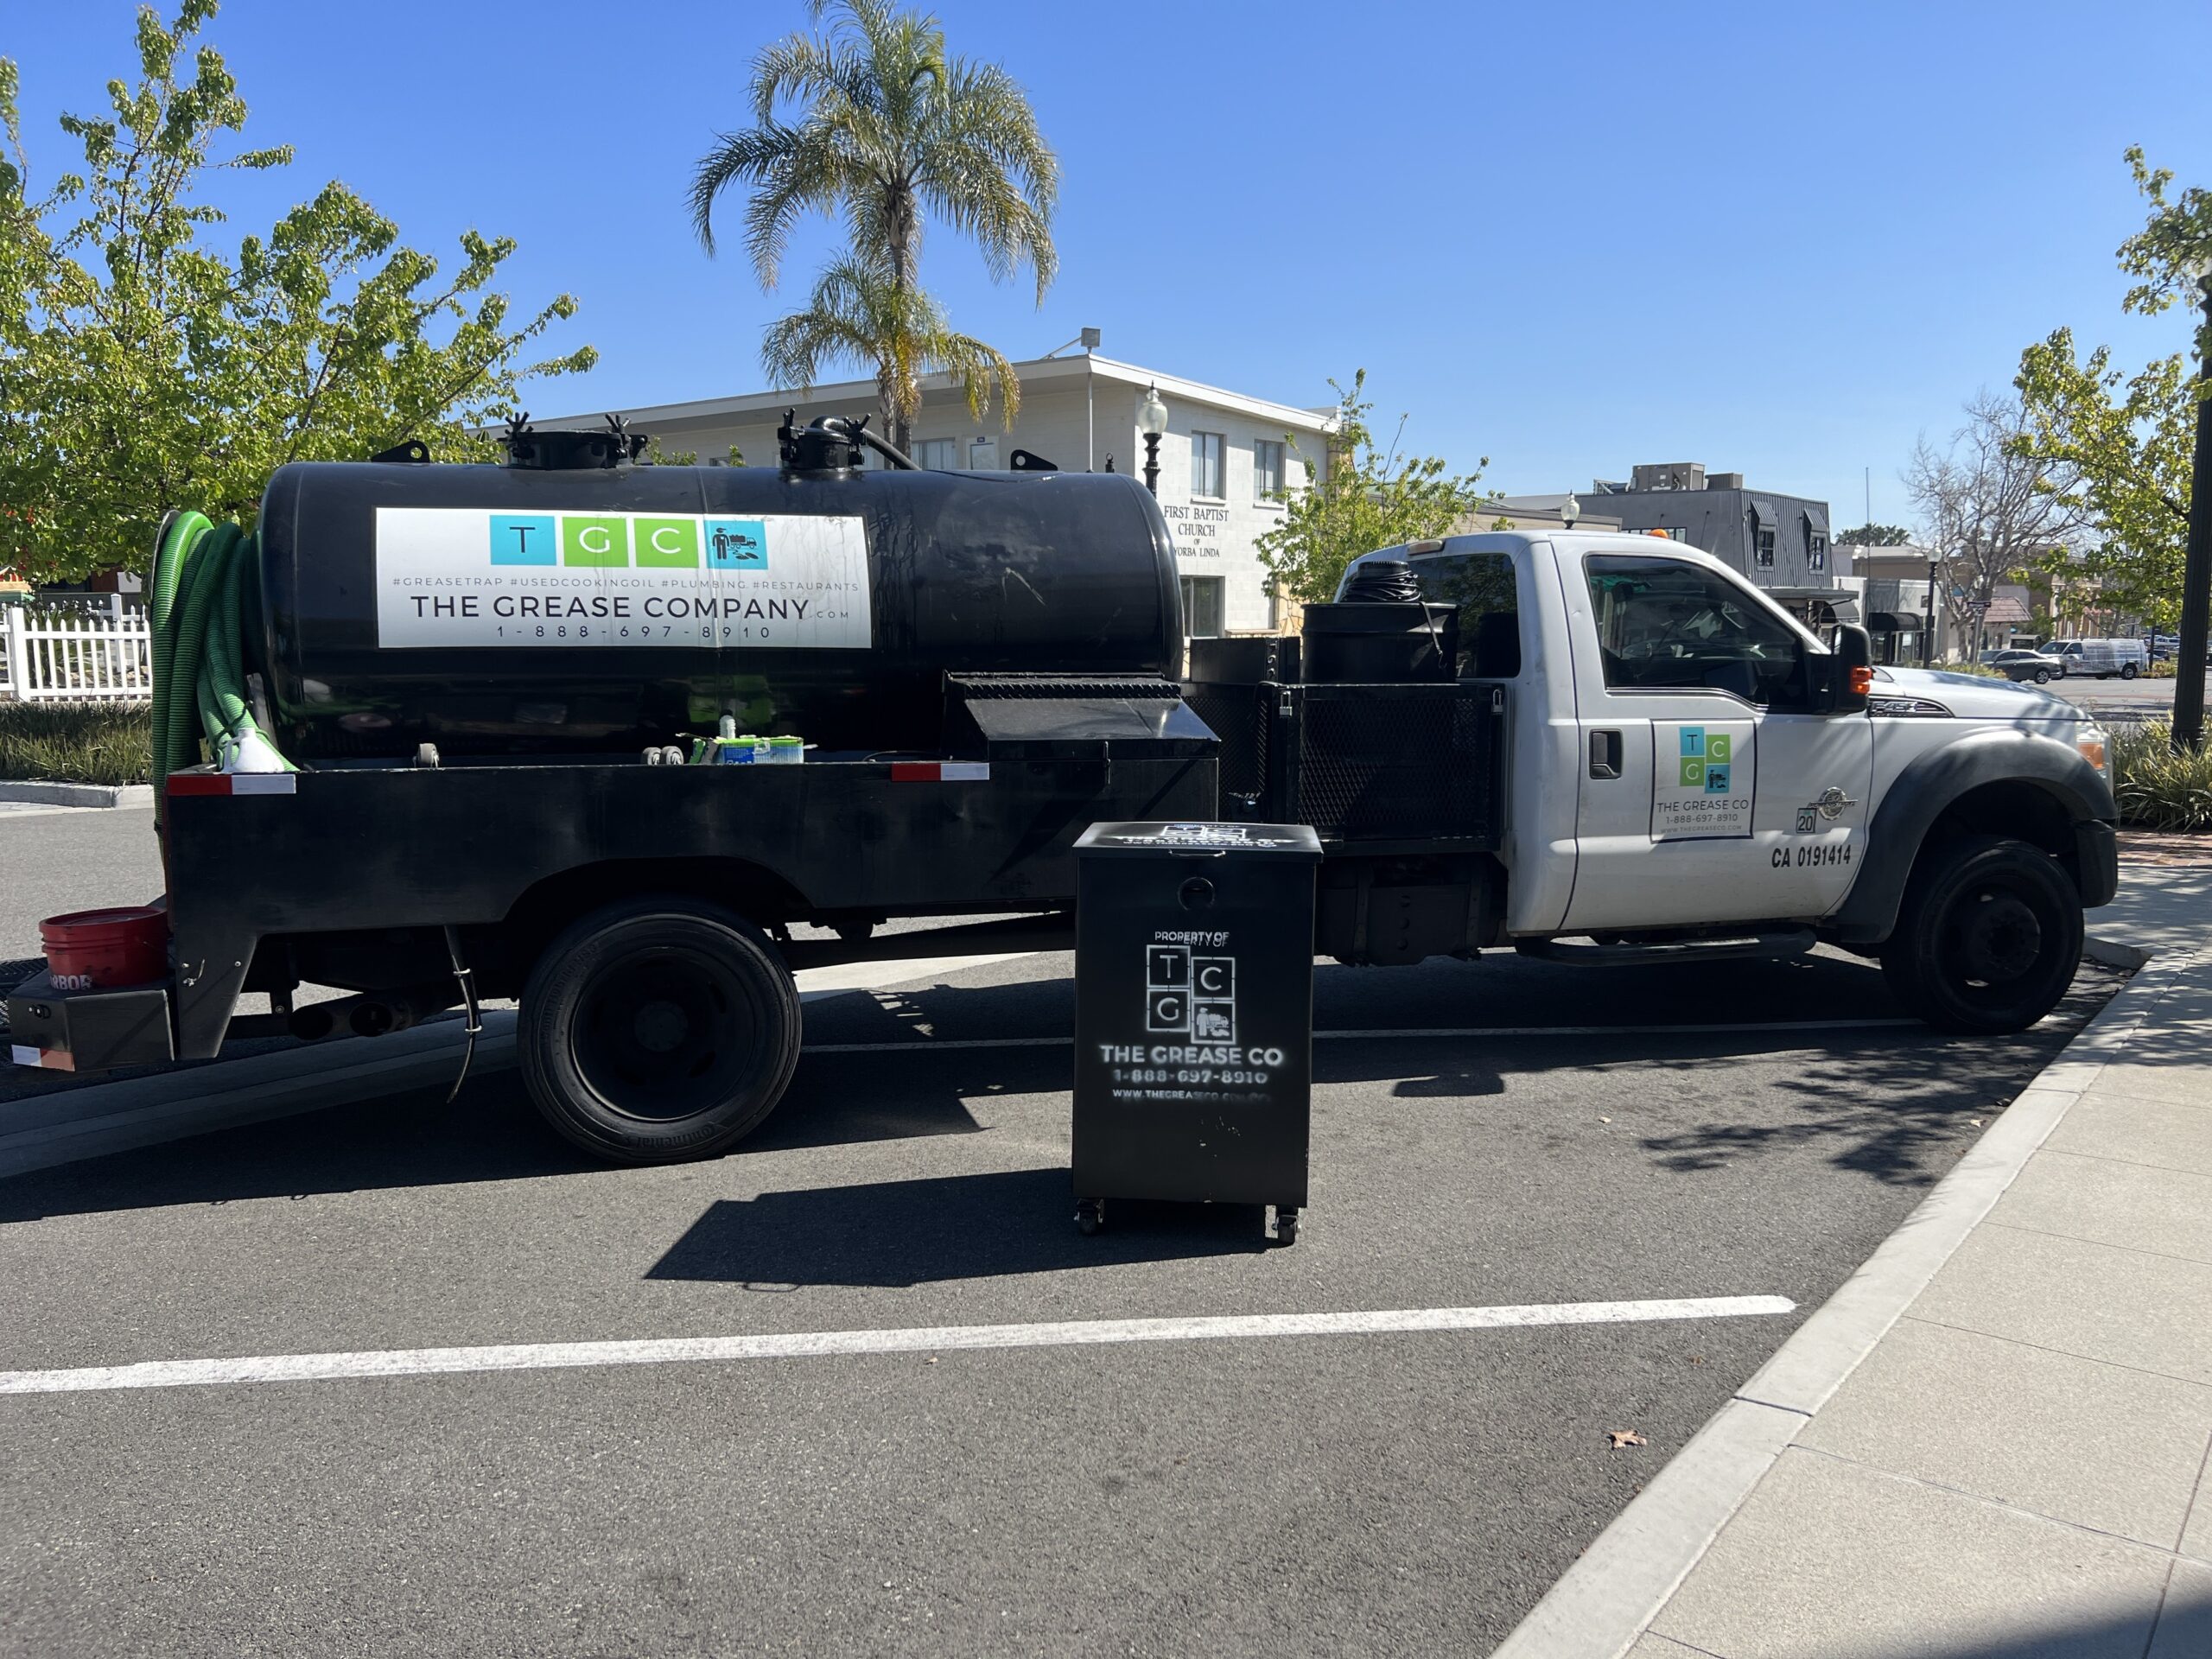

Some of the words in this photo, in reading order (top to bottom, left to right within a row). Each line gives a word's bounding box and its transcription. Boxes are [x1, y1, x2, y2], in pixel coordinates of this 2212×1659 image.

[1164, 505, 1189, 519] FIRST
[1194, 508, 1229, 521] BAPTIST
[1178, 523, 1215, 537] CHURCH
[509, 526, 536, 553] T
[579, 526, 610, 553] G
[651, 528, 682, 554] C
[1200, 548, 1219, 557] LINDA
[393, 577, 503, 587] #GREASETRAP
[511, 578, 654, 588] #USEDCOOKINGOIL
[661, 580, 747, 589] #PLUMBING
[753, 582, 859, 592] #RESTAURANTS
[410, 596, 480, 617] THE
[493, 595, 631, 618] GREASE
[497, 626, 769, 639] 1-888-697-8910
[1687, 734, 1698, 751] T
[1711, 741, 1726, 758] C
[1686, 763, 1700, 779] G
[1657, 801, 1680, 813] THE
[1683, 800, 1729, 811] GREASE
[1732, 799, 1749, 810] CO
[1666, 814, 1738, 824] 1-888-697-8910
[1798, 815, 1814, 831] 20
[1771, 848, 1791, 868] CA
[1797, 844, 1852, 868] 0191414
[1154, 931, 1212, 943] PROPERTY
[1214, 931, 1230, 944] OF
[1160, 955, 1179, 979] T
[1200, 966, 1223, 991] C
[1157, 997, 1179, 1021] G
[1099, 1045, 1146, 1063] THE
[1150, 1046, 1243, 1065] GREASE
[1248, 1047, 1284, 1067] CO
